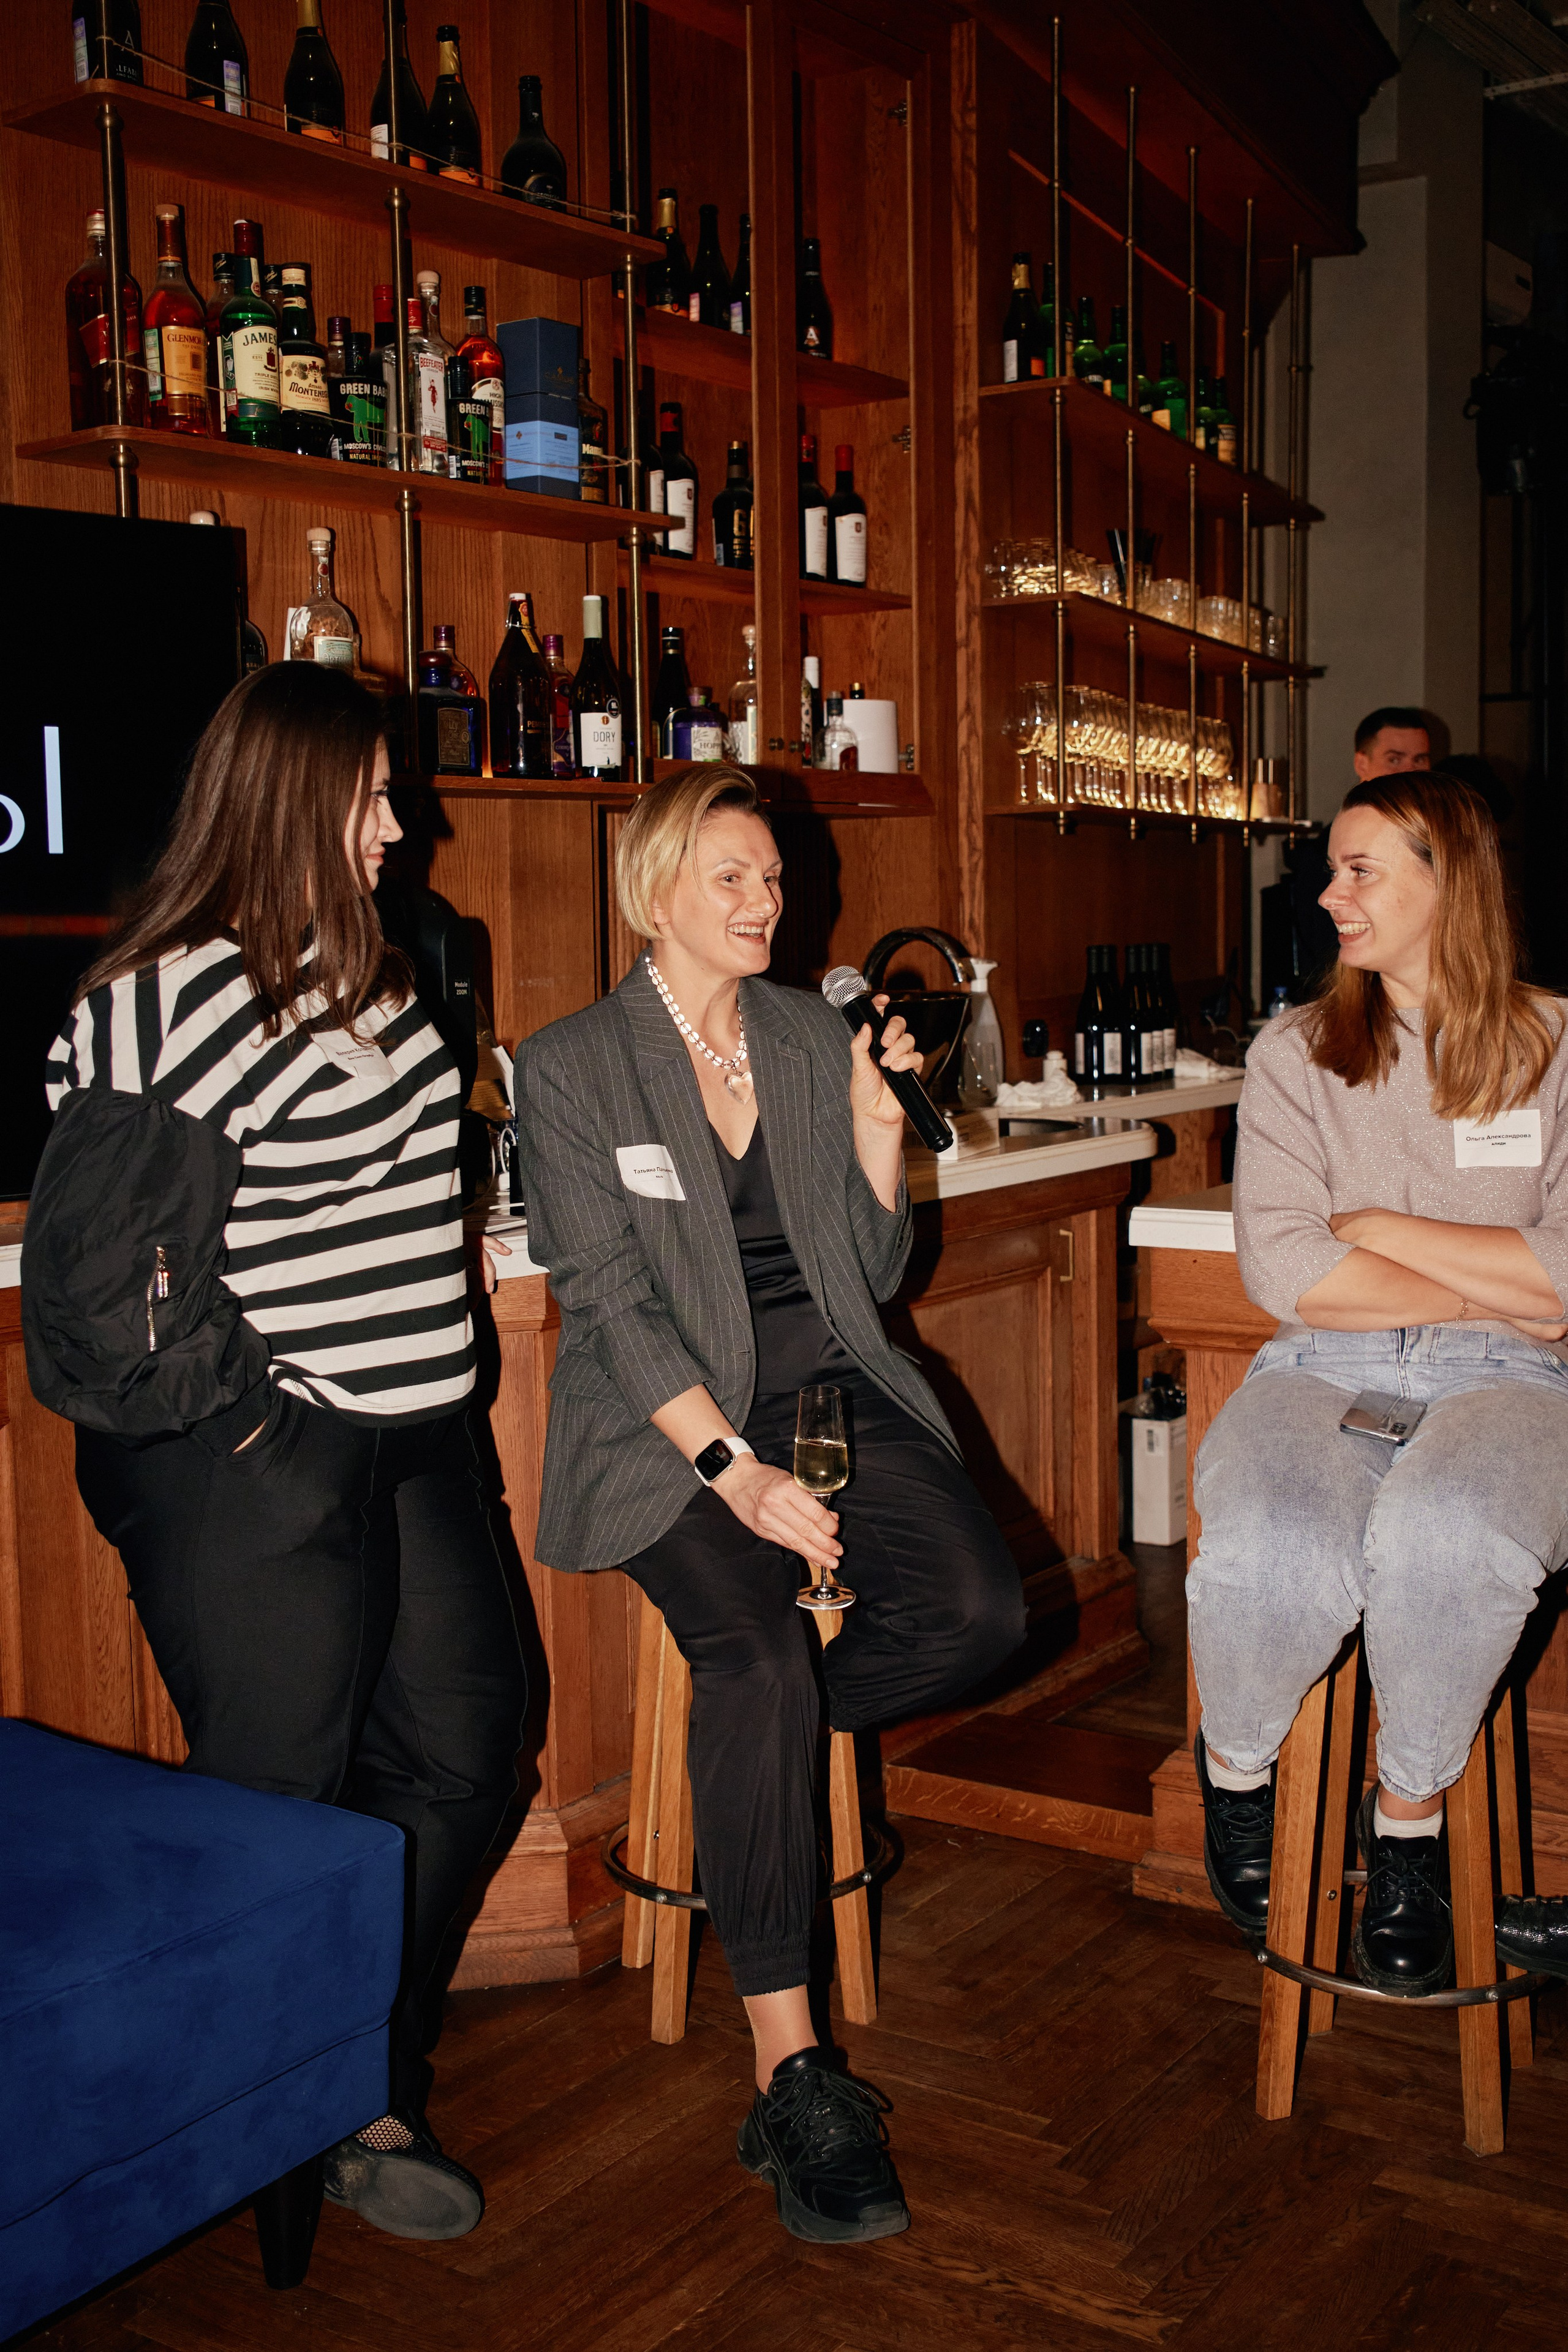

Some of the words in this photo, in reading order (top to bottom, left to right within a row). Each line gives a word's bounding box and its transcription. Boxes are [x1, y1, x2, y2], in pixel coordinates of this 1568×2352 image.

[243, 333, 277, 347] JAMES
[420, 357, 444, 374] BEEFEATER
[288, 382, 328, 399] MONTENEG
[339, 382, 371, 395] GREEN
[372, 384, 388, 398] BAB
[459, 402, 486, 415] GREEN
[593, 731, 616, 743] DORY
